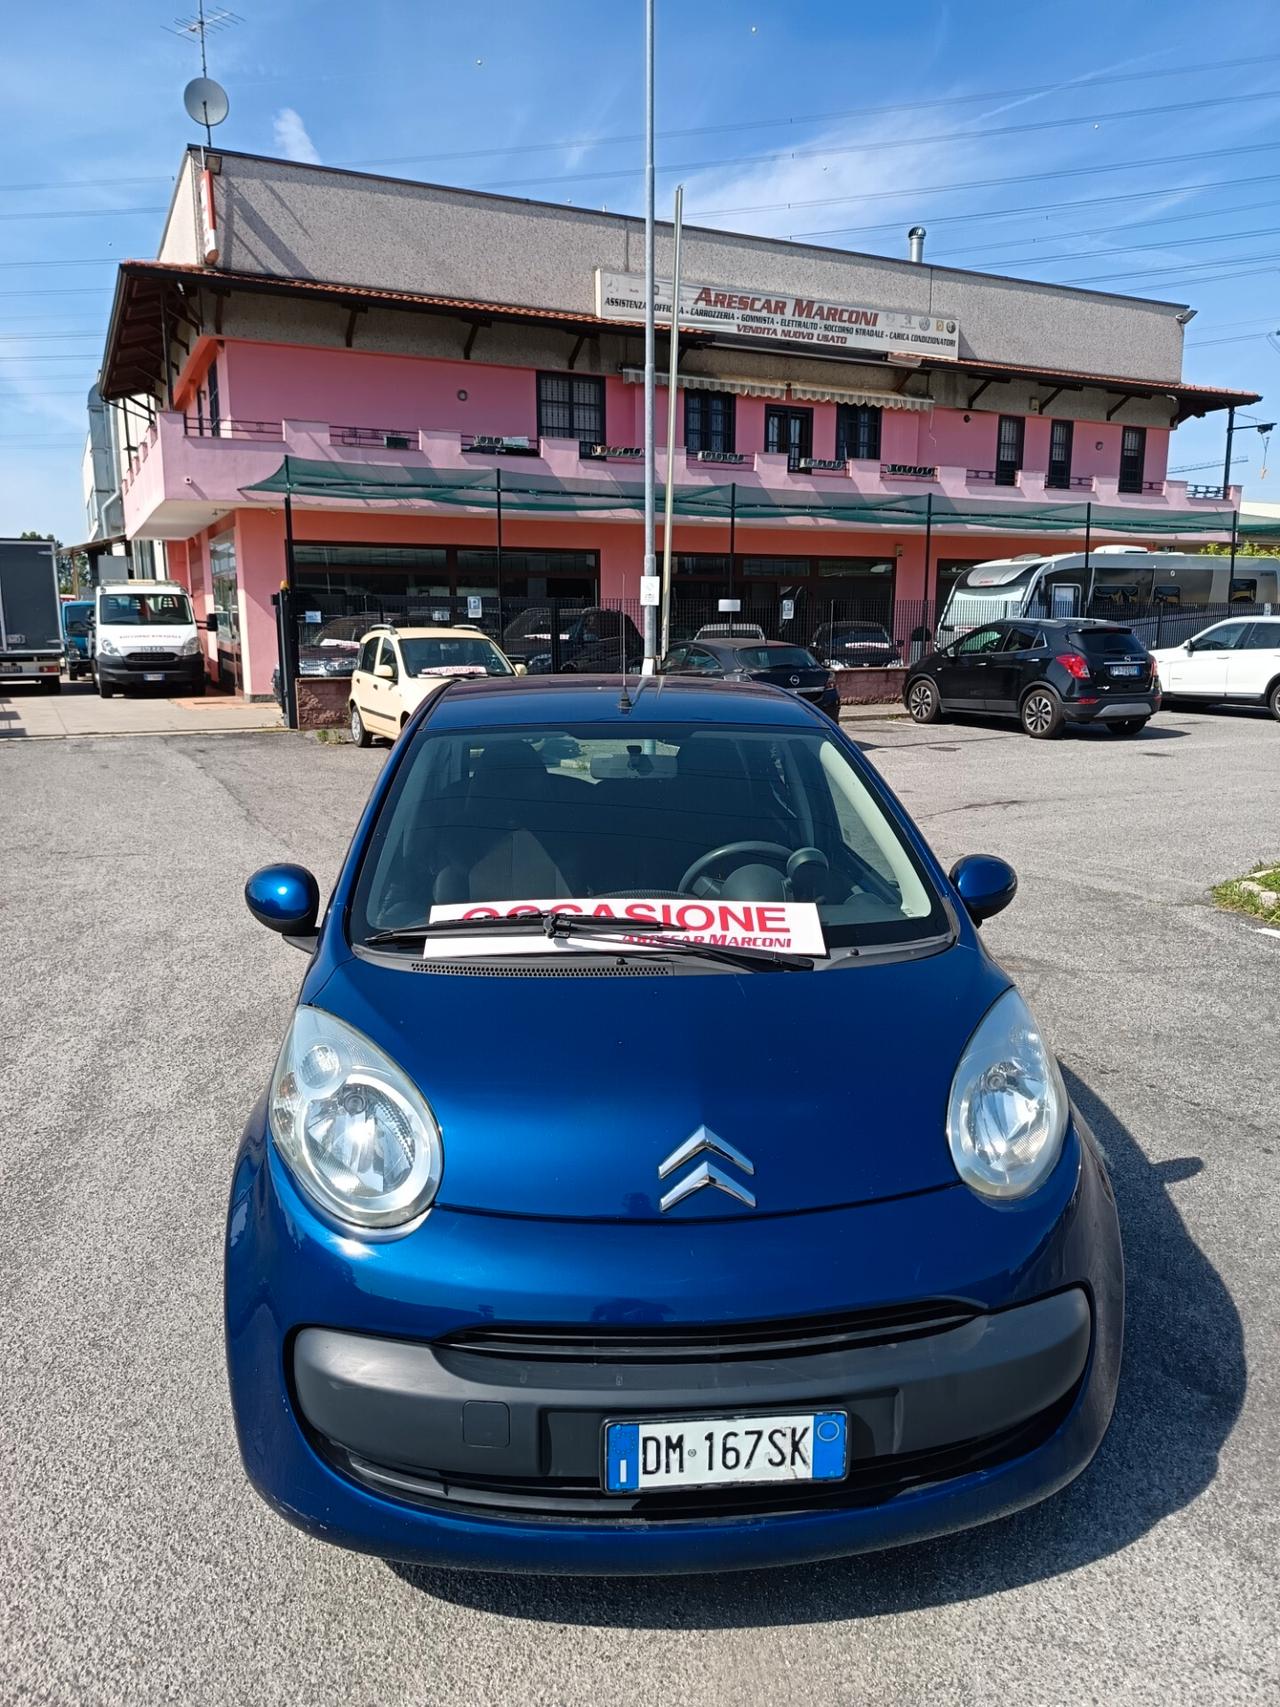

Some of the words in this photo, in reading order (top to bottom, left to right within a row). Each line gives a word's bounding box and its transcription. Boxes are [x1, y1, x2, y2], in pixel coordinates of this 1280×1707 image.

[654, 303, 684, 314] OFFICA
[690, 308, 735, 321] CARROZZERIA
[741, 313, 775, 326] GOMMISTA
[780, 319, 818, 331] ELETTRAUTO
[823, 324, 854, 335] SOCCORSO
[855, 328, 884, 339] STRADALE
[889, 332, 910, 341] CARICA
[910, 334, 956, 347] CONDIZIONATORI
[693, 287, 787, 315] ARESCAR
[791, 298, 879, 327] MARCONI
[736, 324, 778, 337] VENDITA
[780, 329, 814, 341] NUOVO
[816, 333, 848, 345] USATO
[708, 934, 792, 948] MARCONI
[642, 1434, 684, 1475] DM
[704, 1426, 810, 1471] 167SK
